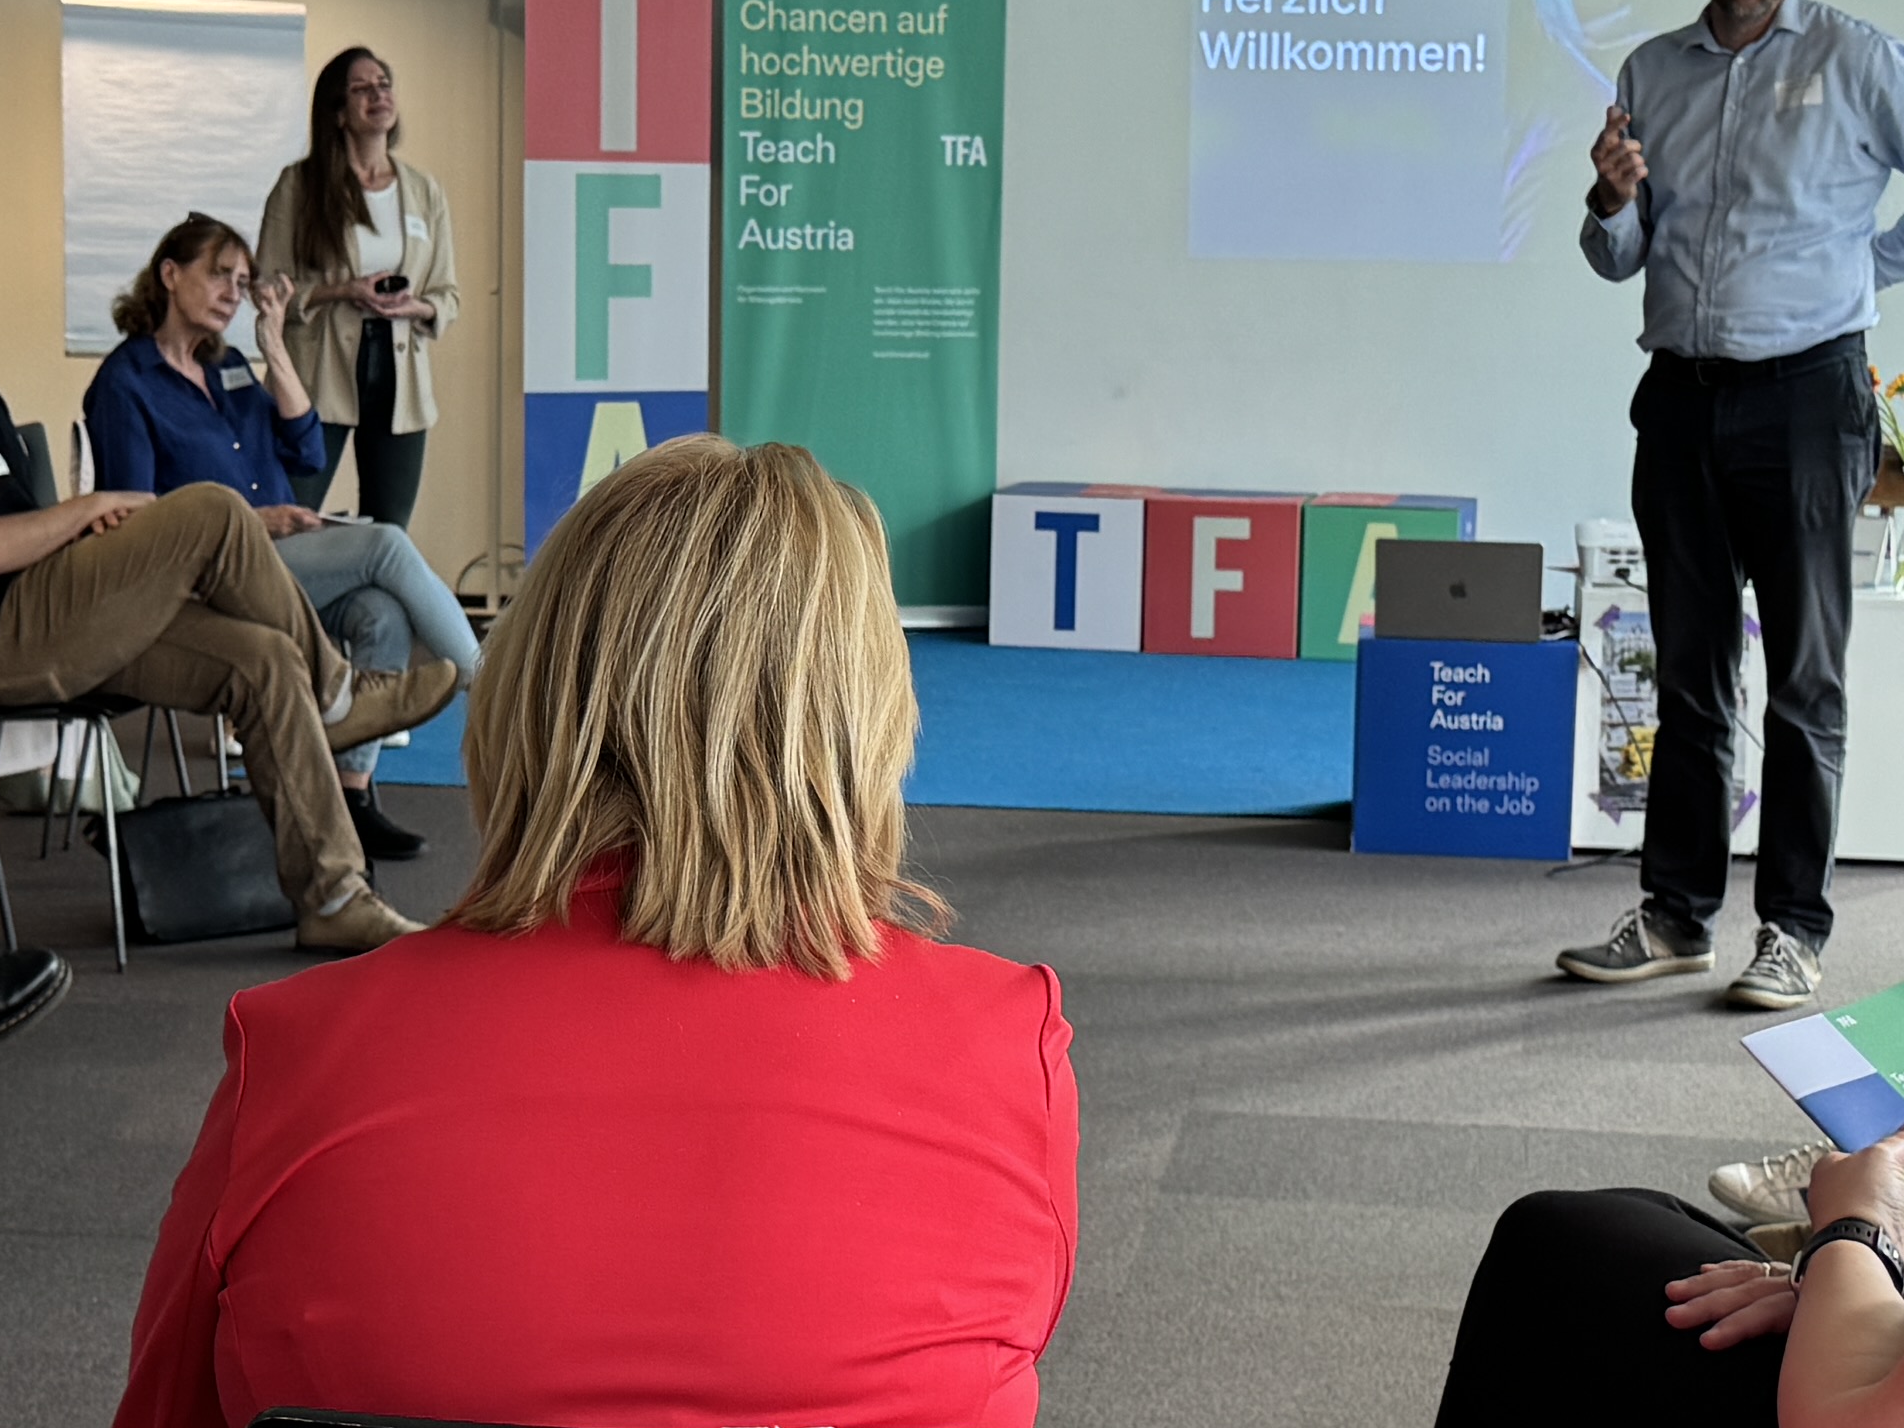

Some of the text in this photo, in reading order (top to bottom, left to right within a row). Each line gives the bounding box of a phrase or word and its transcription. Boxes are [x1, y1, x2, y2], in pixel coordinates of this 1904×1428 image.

[897, 3, 949, 35] auf
[740, 43, 945, 88] hochwertige
[1199, 29, 1487, 73] Willkommen!
[740, 87, 864, 130] Bildung
[739, 130, 836, 164] Teach
[940, 134, 988, 167] TFA
[739, 174, 793, 207] For
[738, 217, 855, 252] Austria
[1429, 660, 1491, 684] Teach
[1431, 684, 1466, 707] For
[1429, 708, 1504, 731] Austria
[1427, 744, 1490, 768] Social
[1426, 768, 1540, 797] Leadership
[1425, 793, 1536, 817] on the Job
